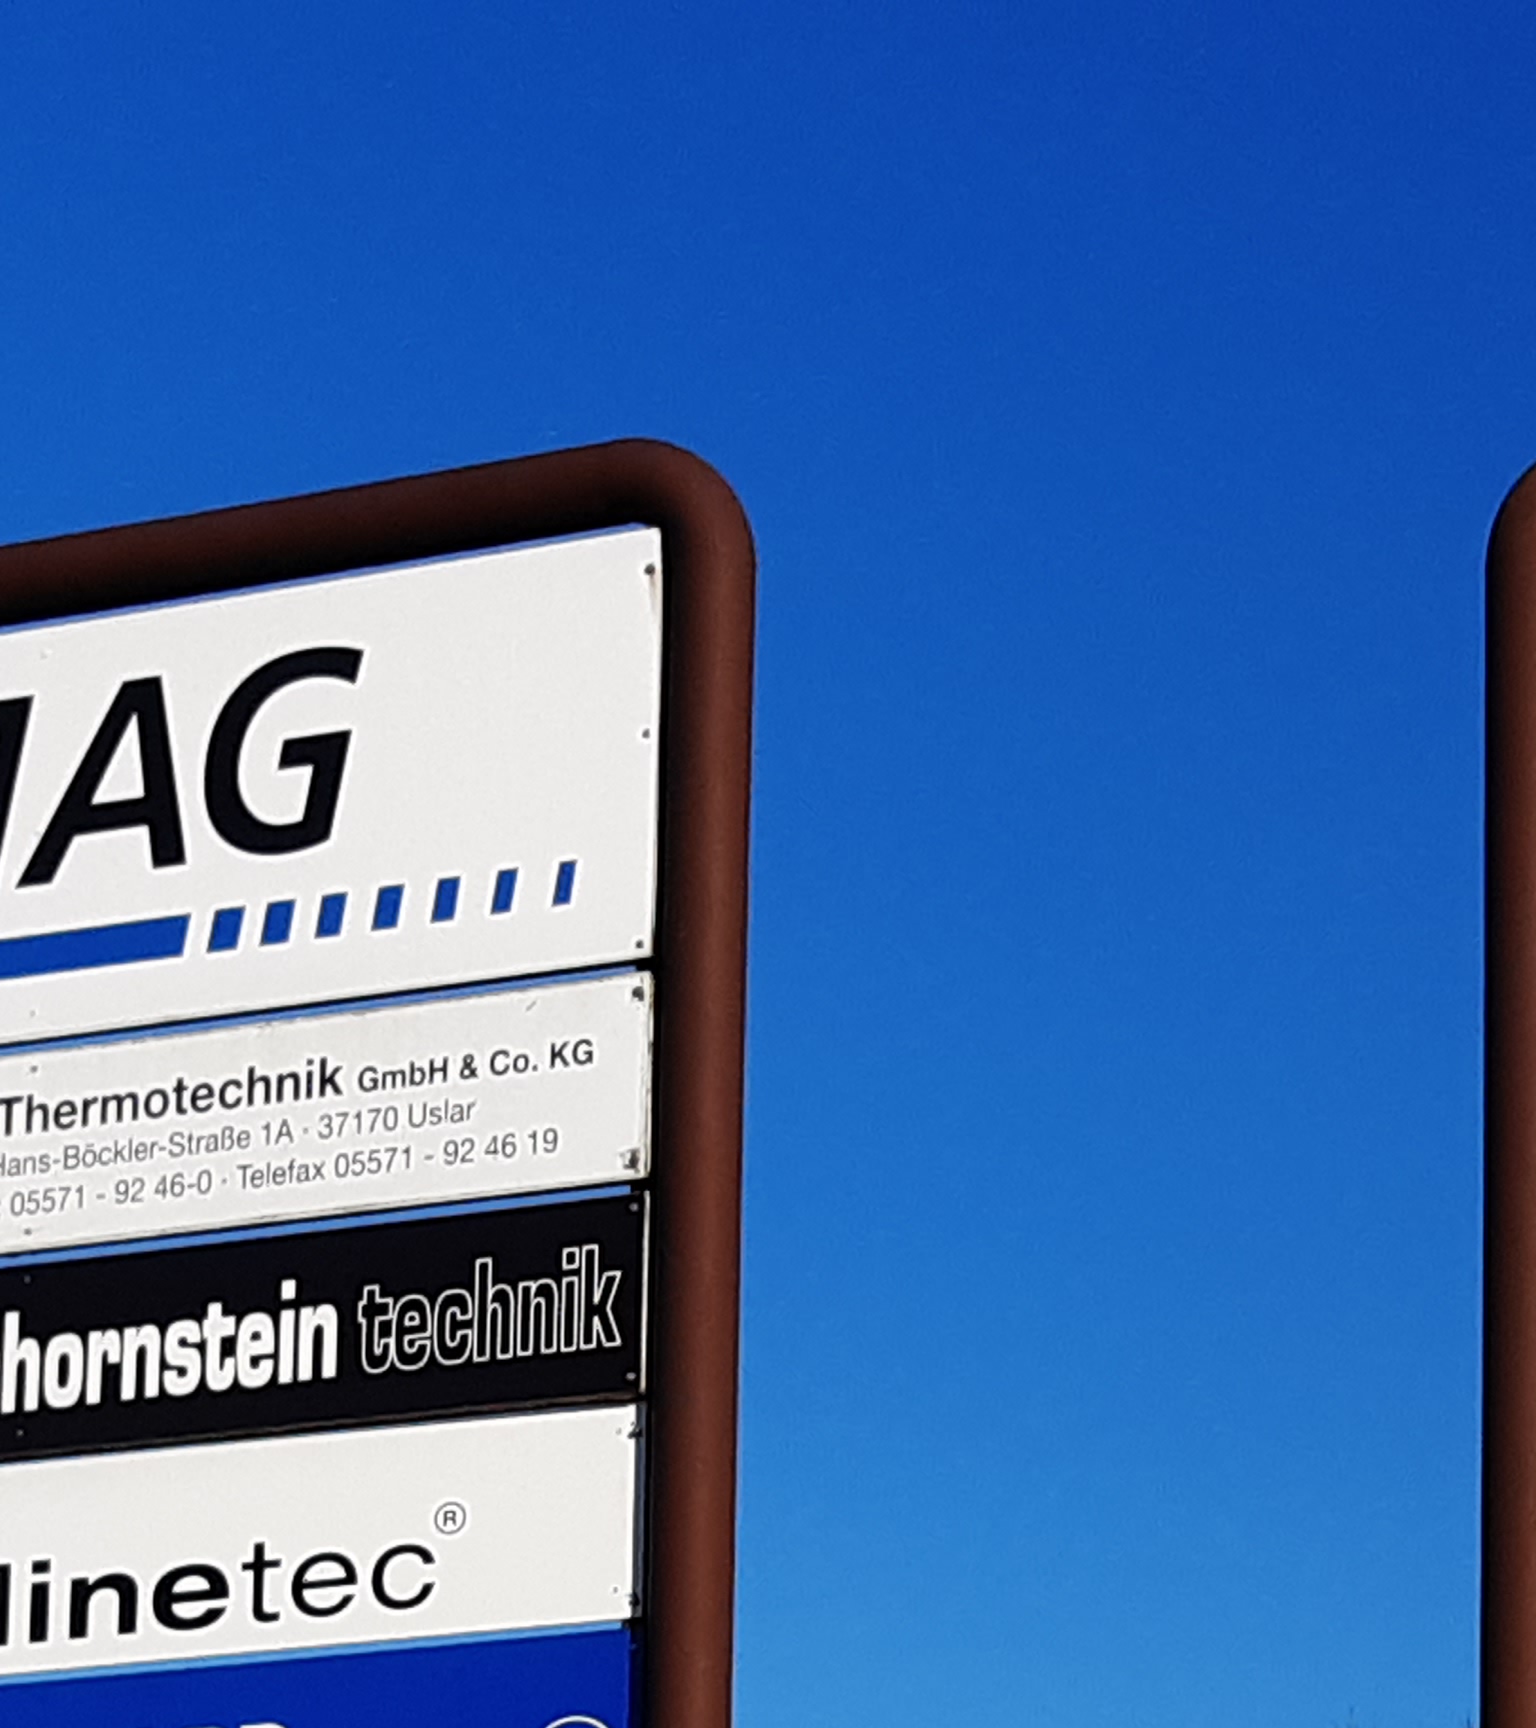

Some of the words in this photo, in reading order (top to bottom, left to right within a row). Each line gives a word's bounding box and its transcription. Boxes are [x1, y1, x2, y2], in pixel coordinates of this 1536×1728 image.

[357, 1060, 449, 1095] GmbH
[459, 1054, 478, 1080] &
[490, 1047, 538, 1077] Co.
[548, 1039, 594, 1070] KG
[262, 1115, 294, 1148] 1A
[317, 1105, 399, 1142] 37170
[407, 1098, 476, 1131] Uslar
[10, 1180, 88, 1219] 05571
[114, 1174, 144, 1206] 92
[154, 1168, 212, 1202] 46-0
[236, 1149, 325, 1191] Telefax
[334, 1146, 413, 1180] 05571
[443, 1136, 474, 1167] 92
[485, 1133, 518, 1161] 46
[526, 1128, 558, 1157] 19
[358, 1245, 624, 1373] technik
